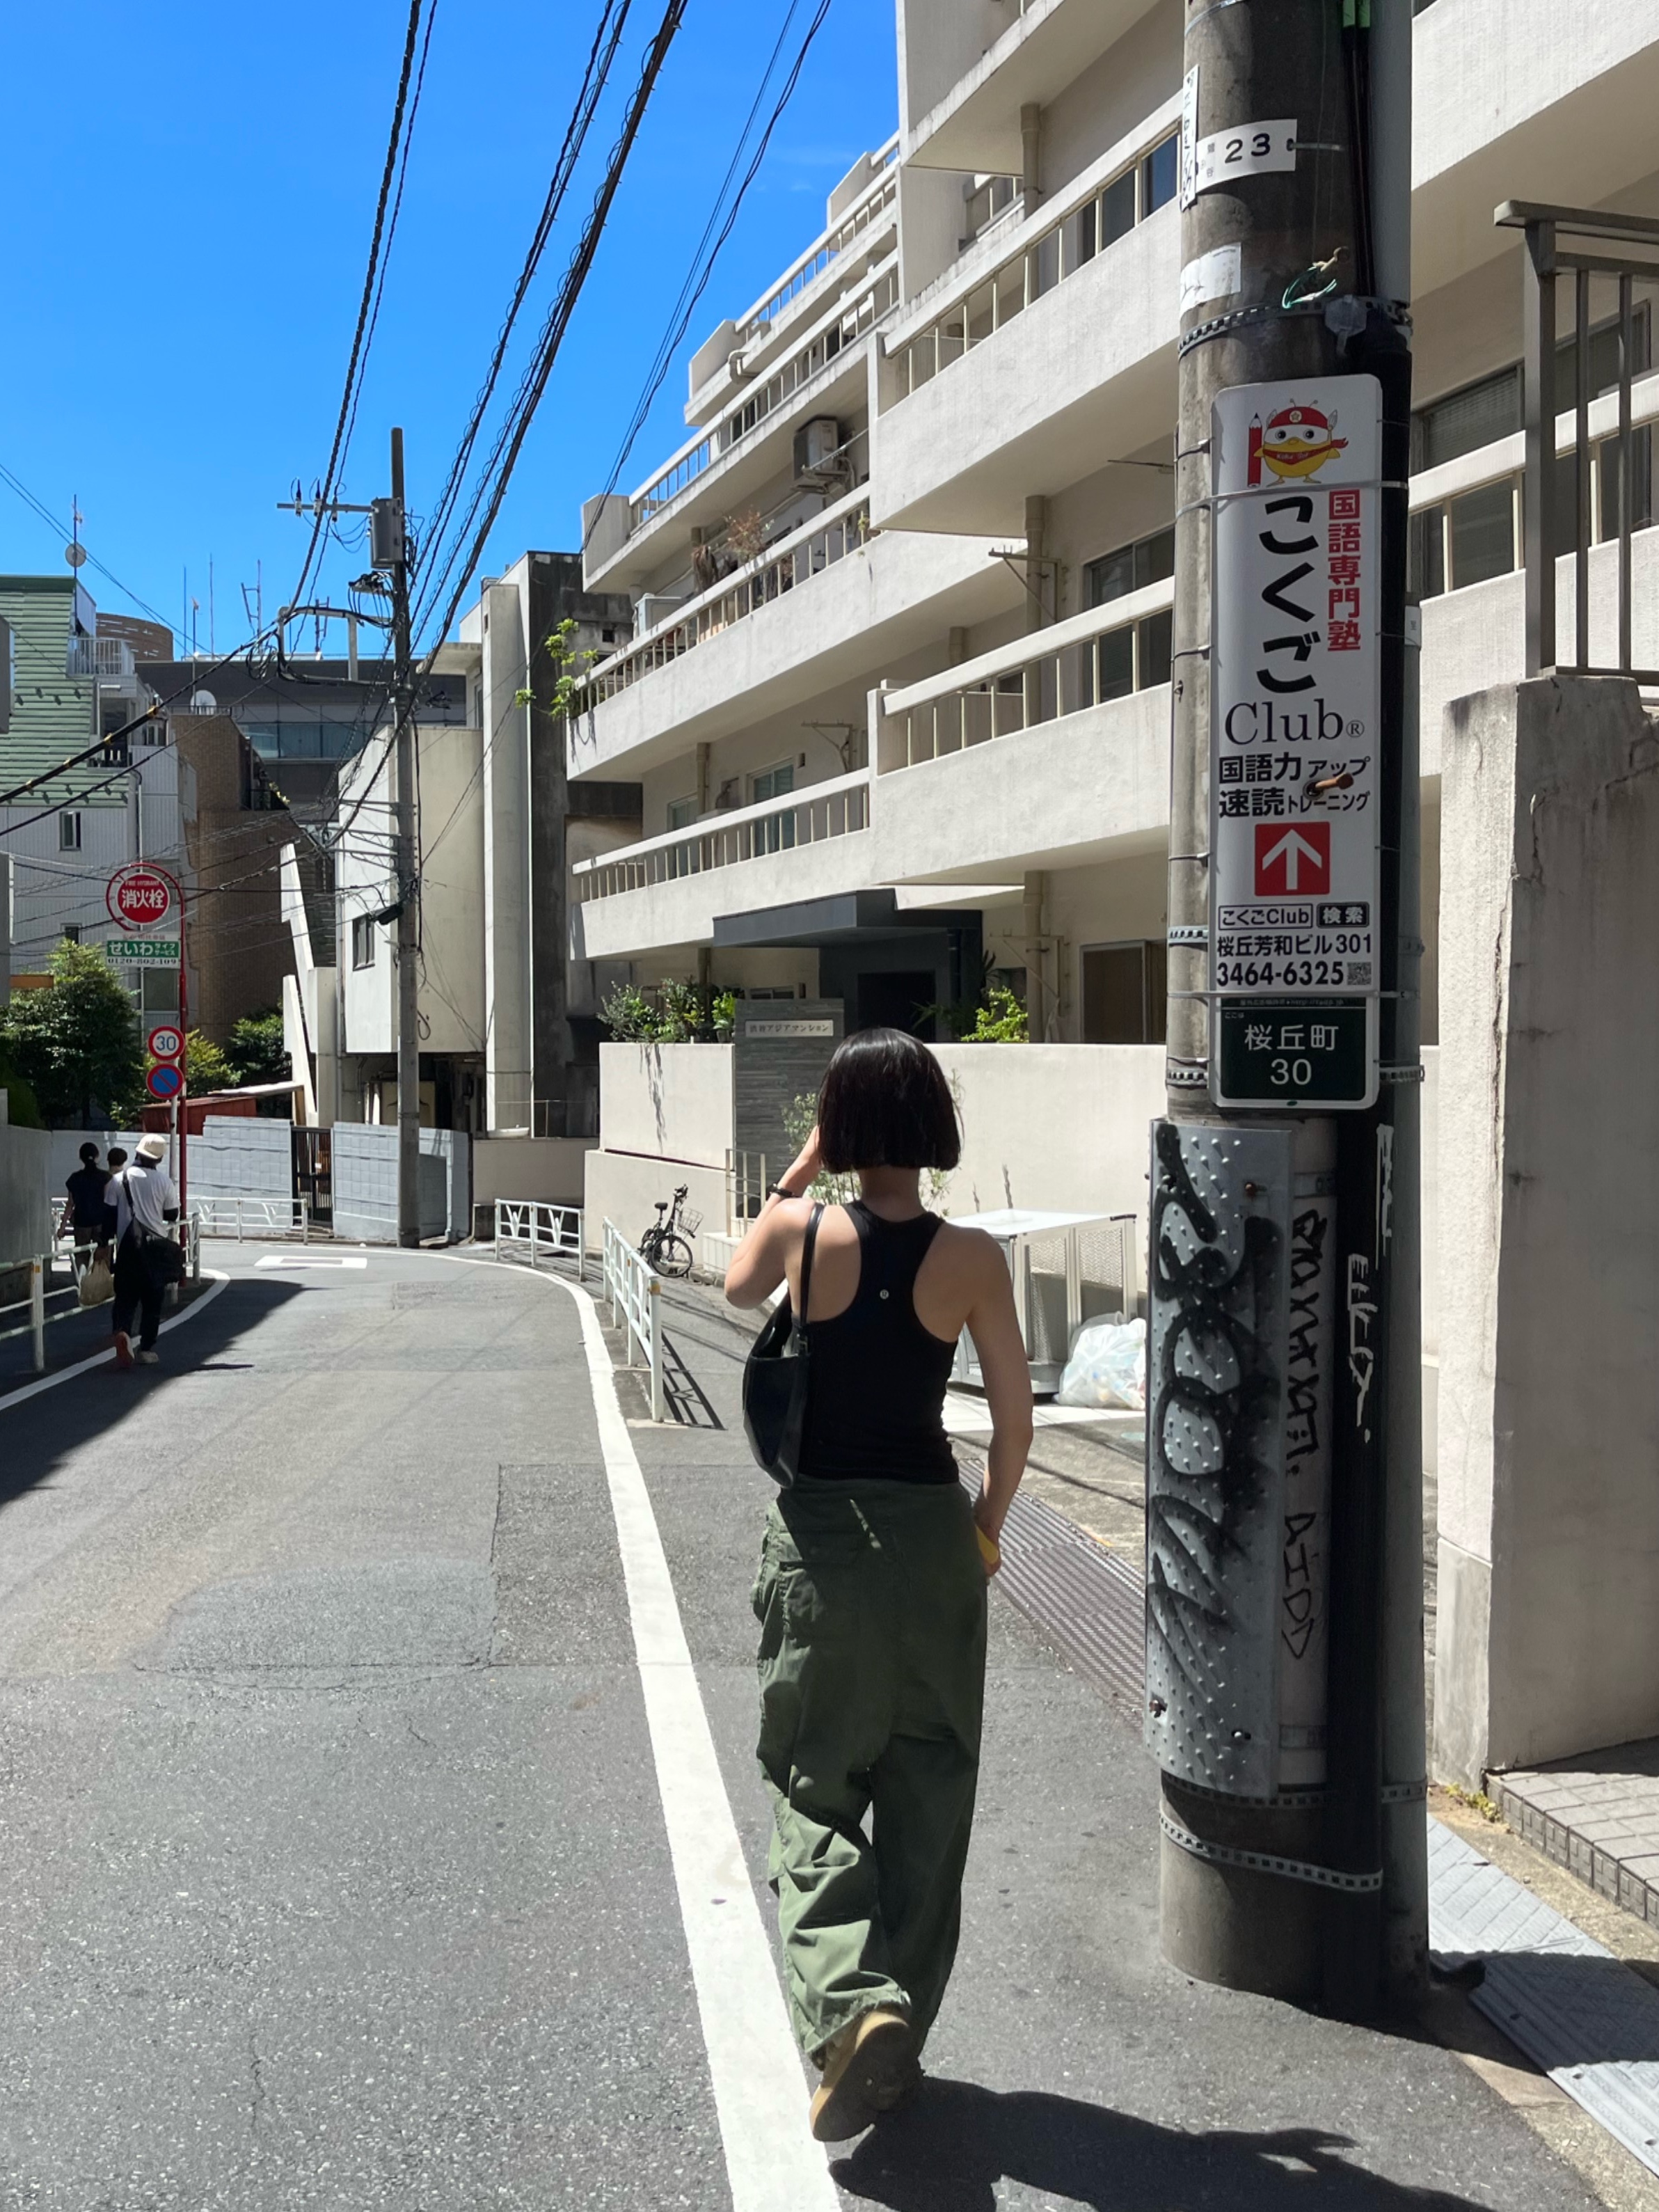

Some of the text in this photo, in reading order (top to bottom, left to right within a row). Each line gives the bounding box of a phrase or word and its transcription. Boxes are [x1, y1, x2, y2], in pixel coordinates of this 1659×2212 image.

[1225, 132, 1271, 164] 23
[1327, 489, 1362, 652] 国語専門塾
[1256, 496, 1321, 695] こくご
[1219, 752, 1371, 784] 国語力アップ
[1219, 787, 1371, 819] 速読トレーニング
[122, 888, 165, 909] 消火栓
[1222, 908, 1310, 926] こくごClub
[1322, 906, 1364, 924] 検索
[109, 942, 154, 956] せいわ
[1216, 961, 1344, 987] 3464-6325
[156, 1035, 177, 1052] 30
[1244, 1024, 1340, 1052] 桜丘町
[1270, 1058, 1312, 1086] 30
